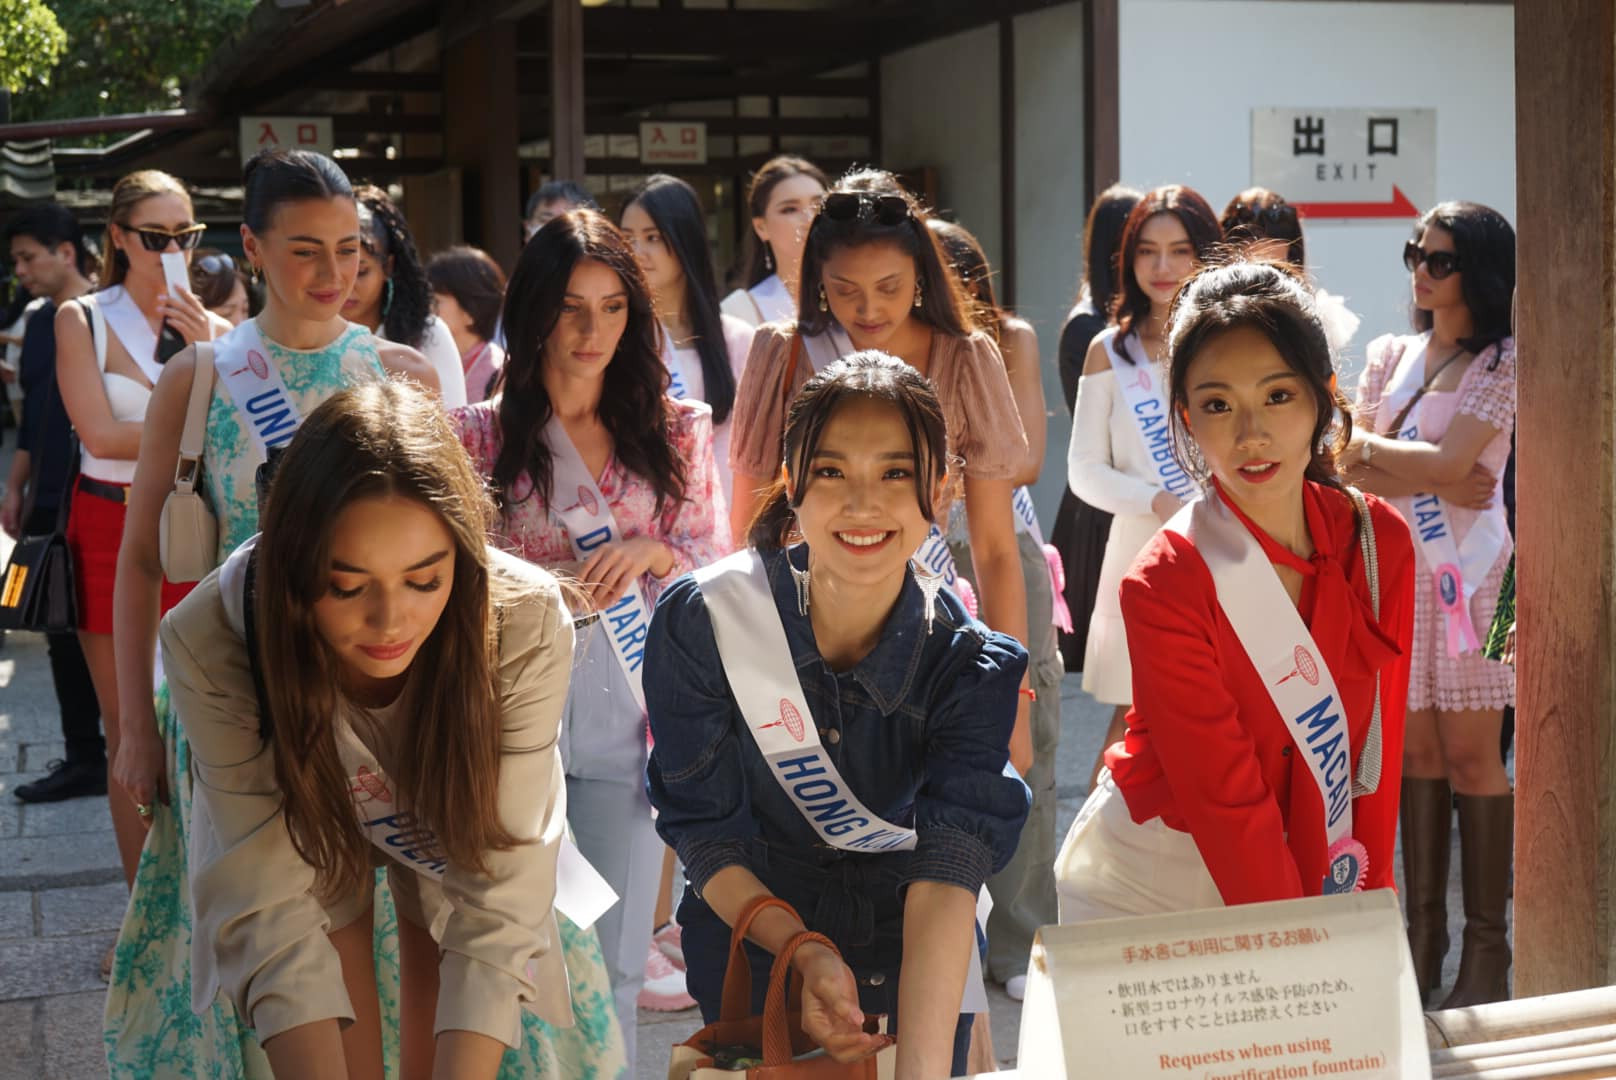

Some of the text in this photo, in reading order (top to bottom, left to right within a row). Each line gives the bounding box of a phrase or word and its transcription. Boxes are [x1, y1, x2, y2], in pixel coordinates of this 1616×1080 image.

[259, 123, 317, 144] 入口
[650, 127, 697, 144] 入口
[1294, 117, 1398, 156] 出口
[1316, 164, 1377, 181] EXIT
[1295, 694, 1348, 828] MACAU
[777, 754, 869, 836] HONG
[362, 812, 448, 875] POLA
[1159, 1036, 1332, 1071] Requests when using
